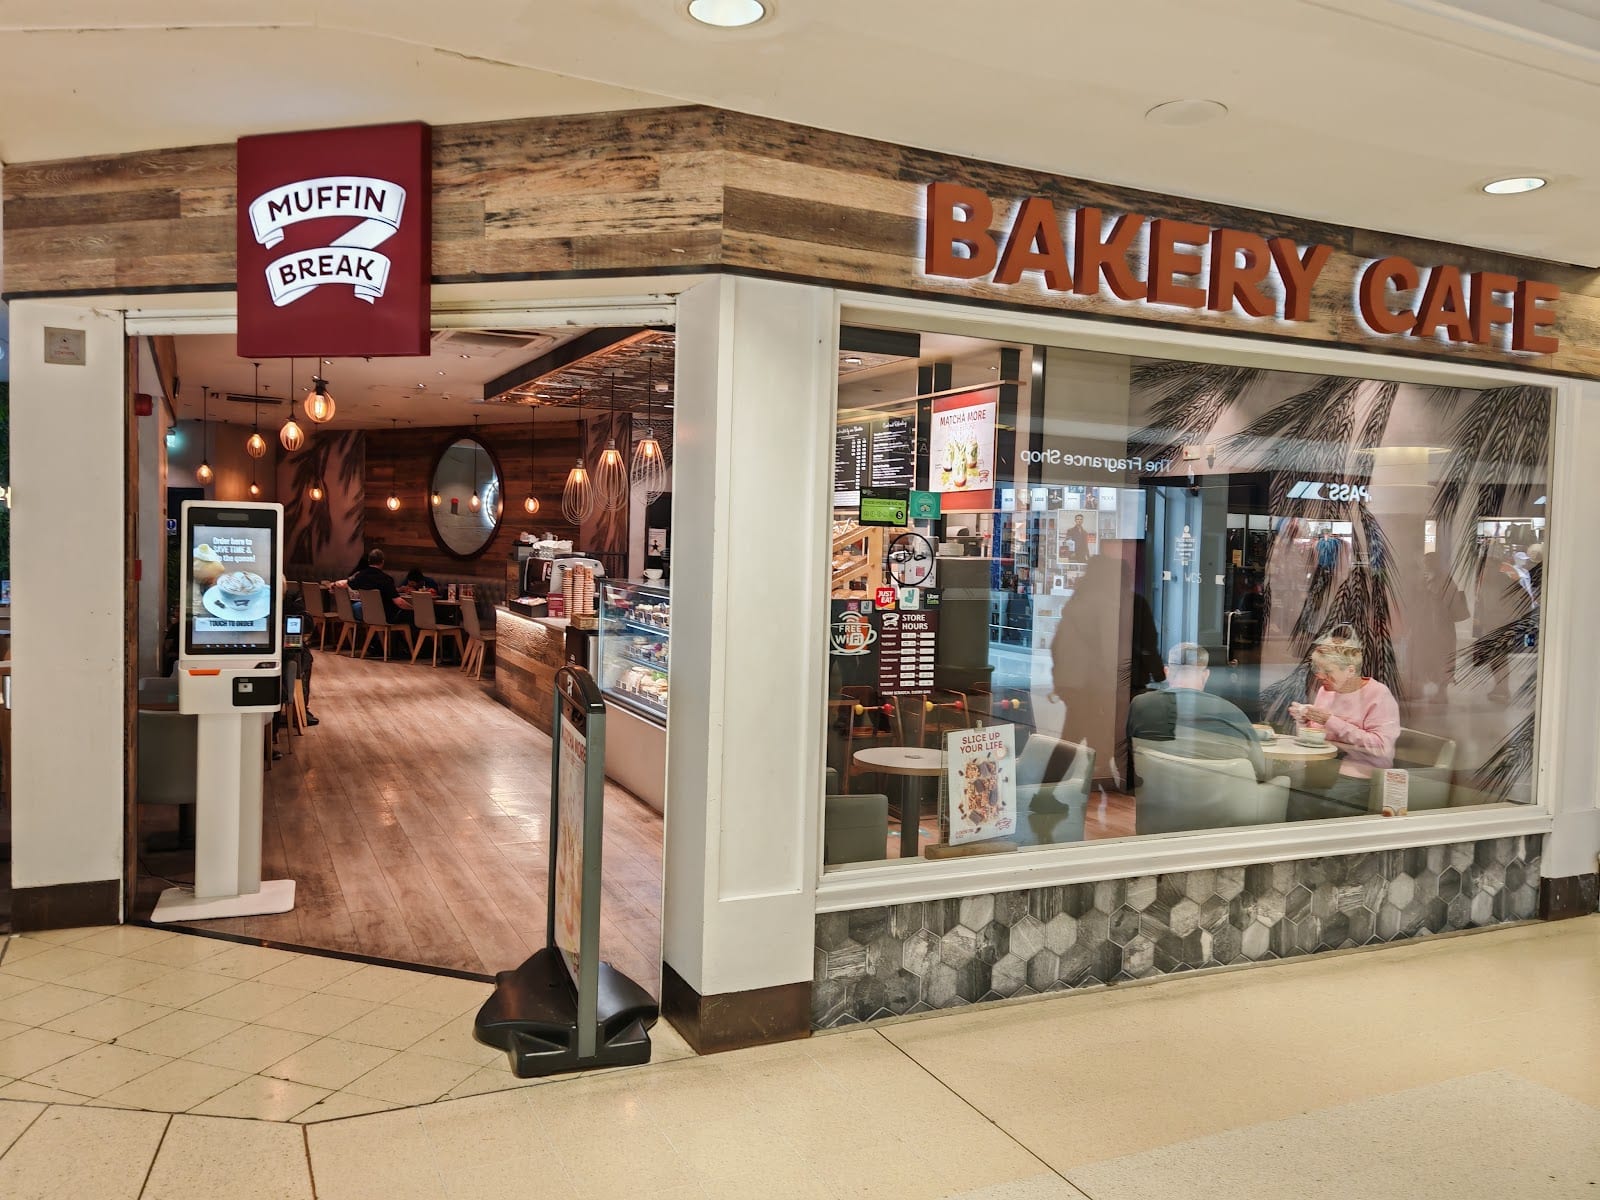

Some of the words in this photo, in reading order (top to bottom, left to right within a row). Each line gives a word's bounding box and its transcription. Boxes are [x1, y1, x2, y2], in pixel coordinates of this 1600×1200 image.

[267, 185, 387, 222] MUFFIN
[278, 254, 375, 286] BREAK
[924, 181, 1334, 322] BAKERY
[1359, 254, 1561, 354] CAFE
[939, 412, 966, 427] MATCHA
[967, 409, 987, 422] MORE
[878, 590, 894, 598] JUST
[902, 614, 926, 622] STORE
[839, 625, 862, 633] FREE
[902, 622, 928, 630] HOURS
[962, 734, 986, 744] SLICE
[989, 732, 1000, 741] UP
[960, 743, 983, 754] YOUR
[985, 741, 1003, 750] LIFE
